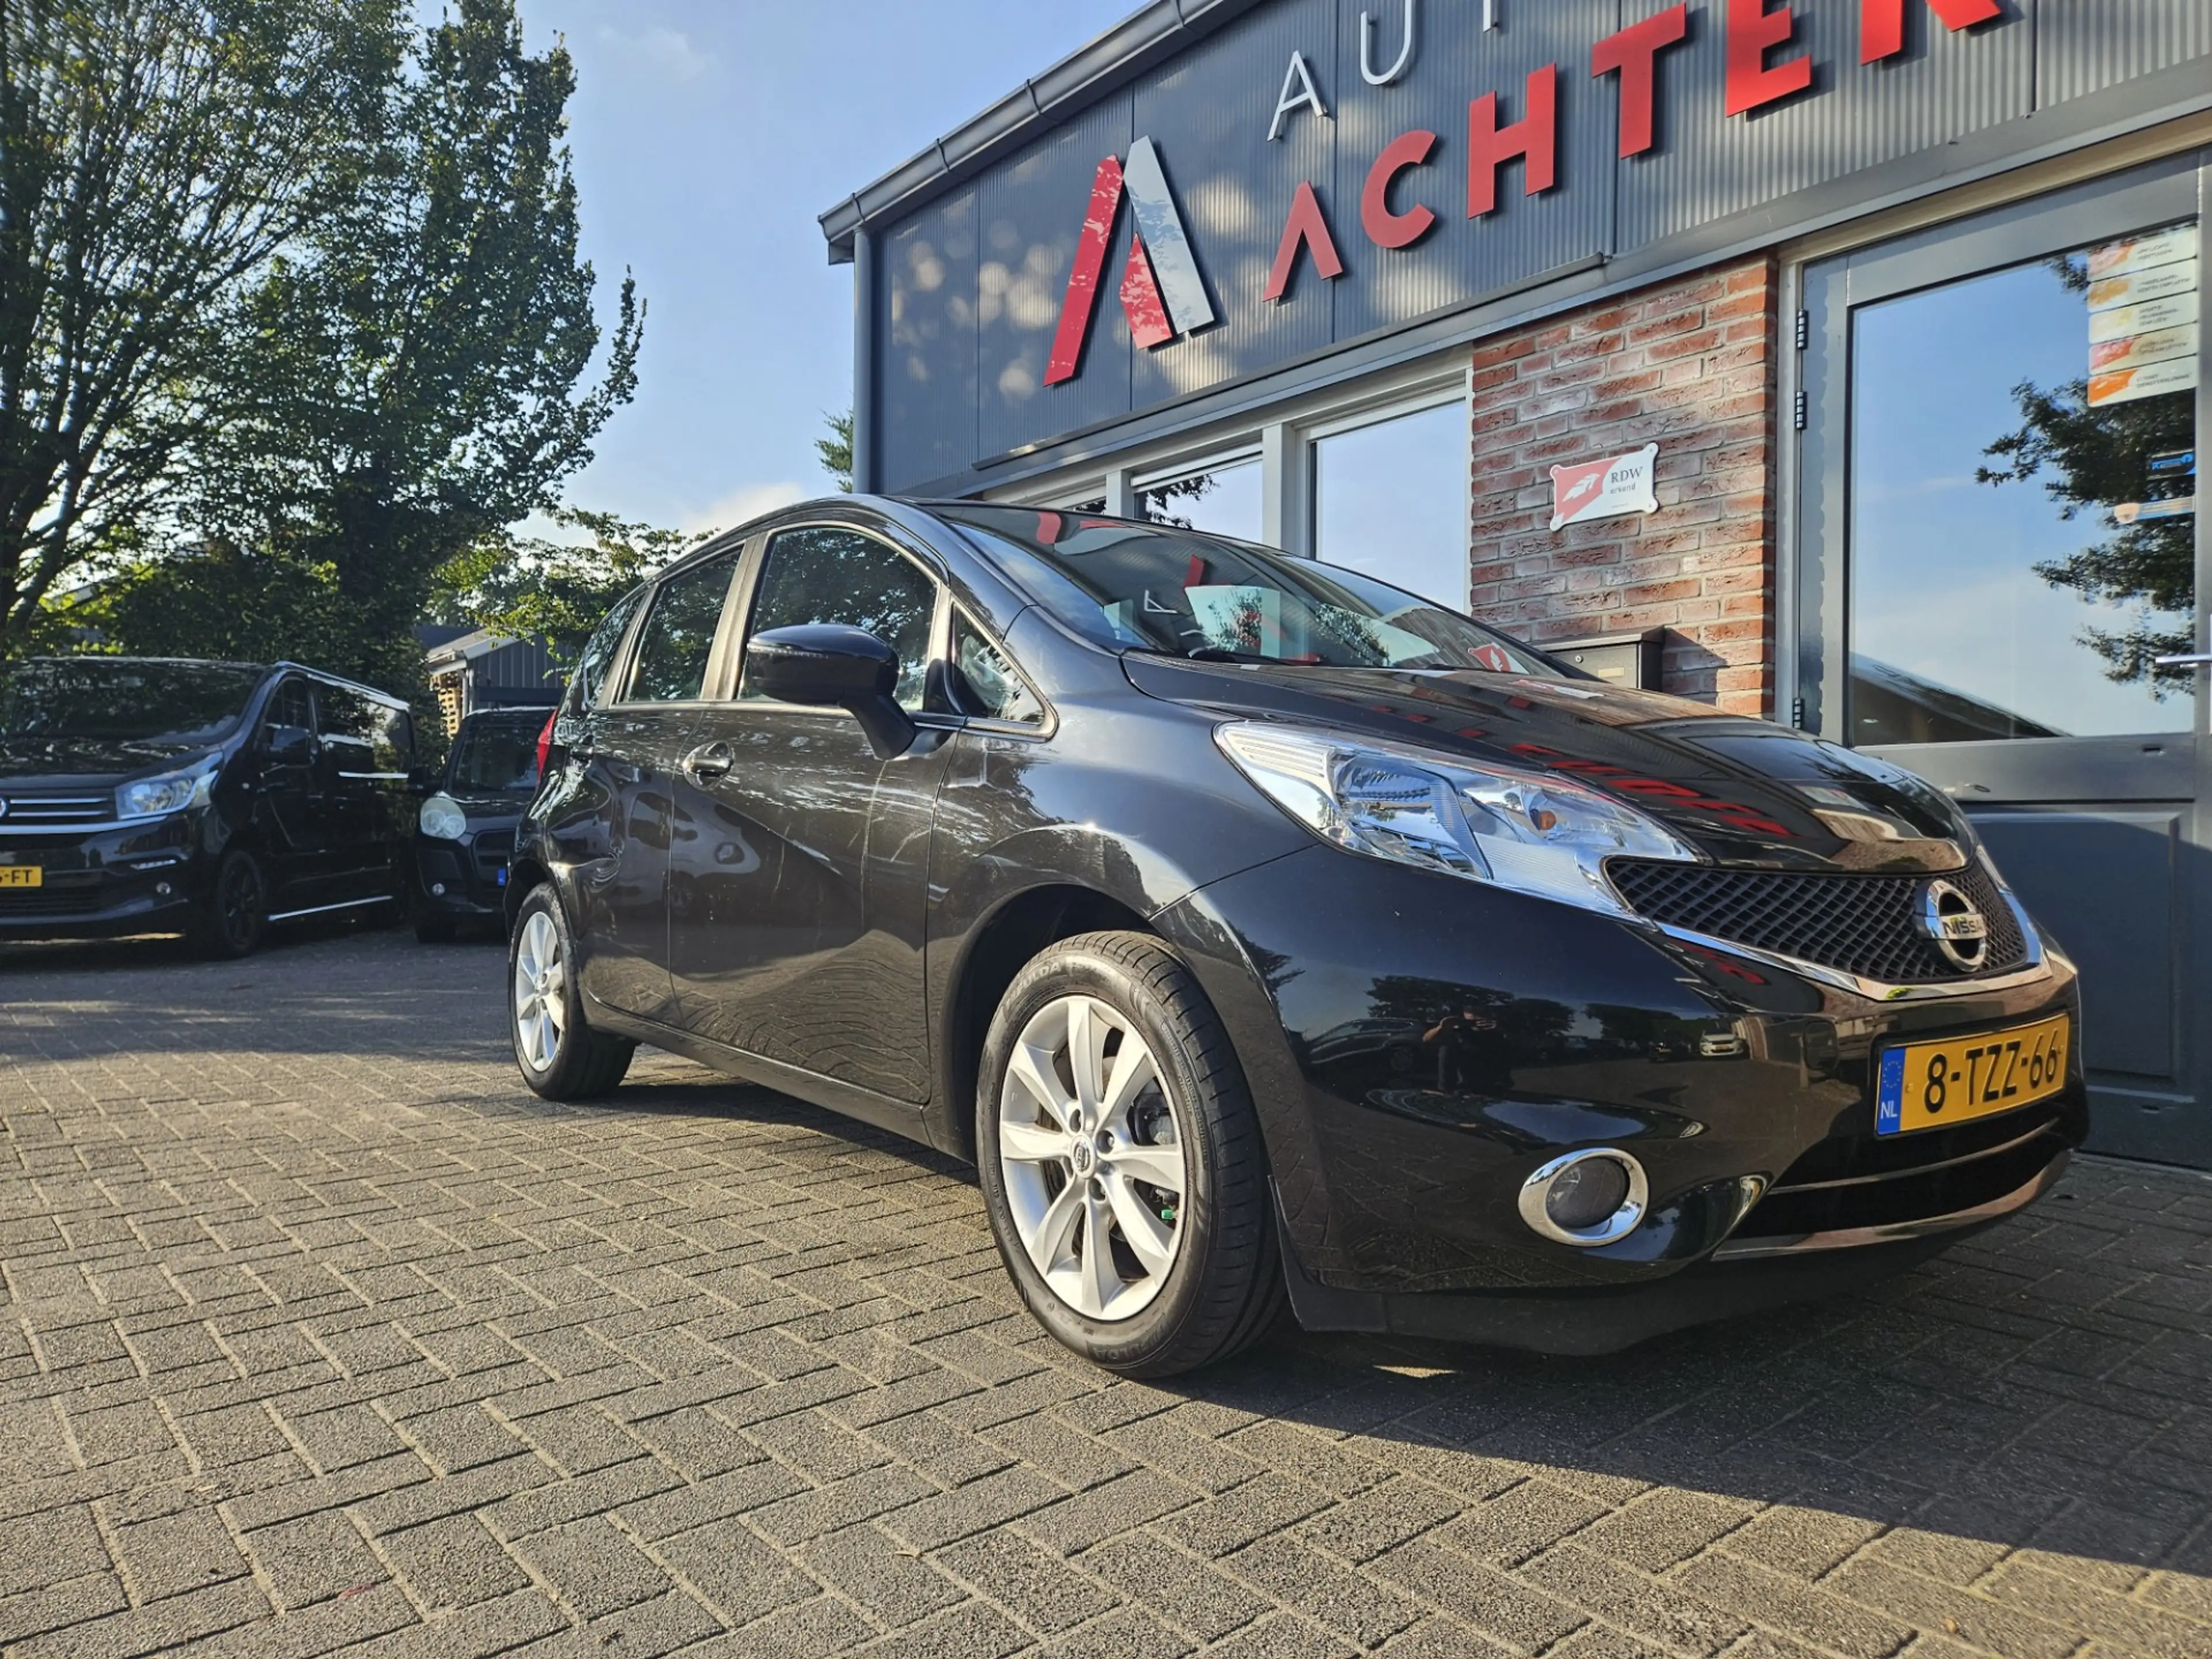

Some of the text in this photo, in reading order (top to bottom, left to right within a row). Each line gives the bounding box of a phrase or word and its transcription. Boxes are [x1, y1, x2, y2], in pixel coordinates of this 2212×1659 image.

[1611, 466, 1643, 483] RDW
[1942, 917, 1985, 938] NISSA
[1923, 1028, 2059, 1113] 8-TZZ-66
[1880, 1100, 1898, 1120] NL
